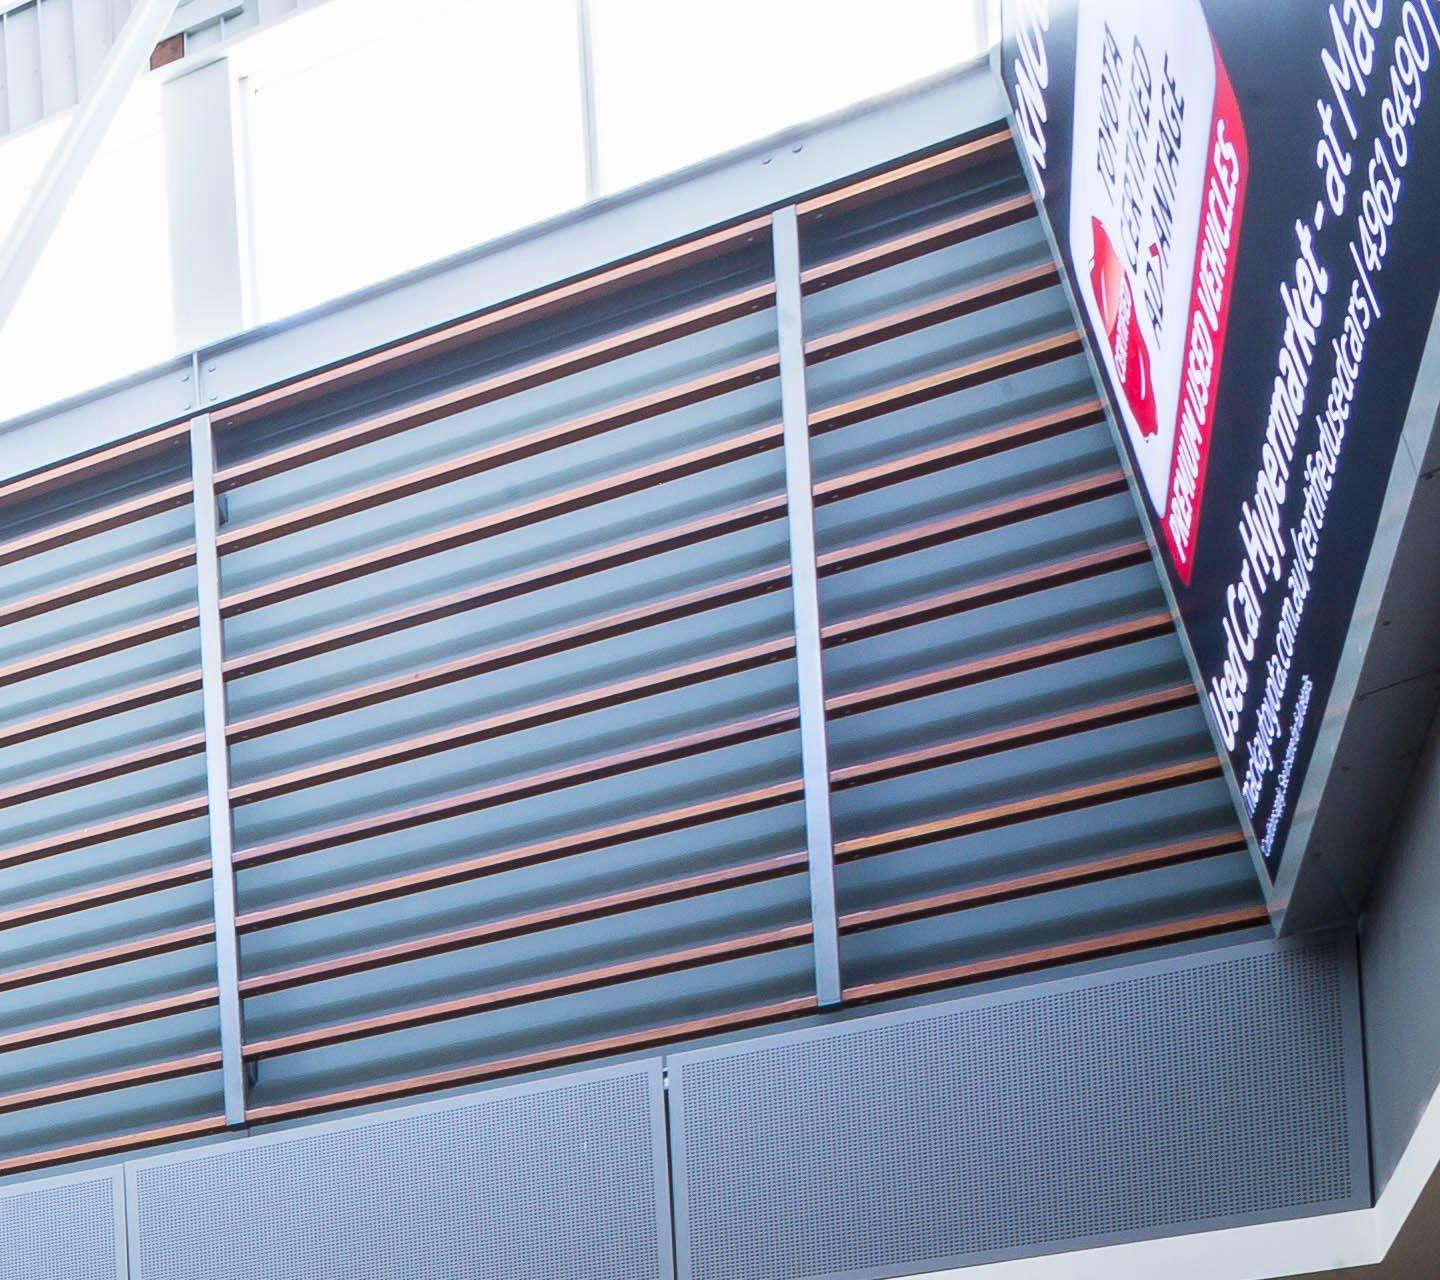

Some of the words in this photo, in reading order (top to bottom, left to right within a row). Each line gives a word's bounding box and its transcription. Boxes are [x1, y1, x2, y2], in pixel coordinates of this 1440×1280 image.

[1096, 20, 1123, 206] TOYOTA
[1119, 34, 1152, 277] CERTIFIED
[1316, 99, 1352, 216] at
[1358, 138, 1400, 271] 4961
[1381, 1, 1430, 167] 8490
[1198, 119, 1239, 331] VEHICLES
[1187, 310, 1214, 425] USED
[1239, 219, 1329, 594] Hypermarket
[1169, 398, 1203, 564] PREMIUM
[1209, 617, 1248, 751] Used
[1228, 568, 1262, 661] Car
